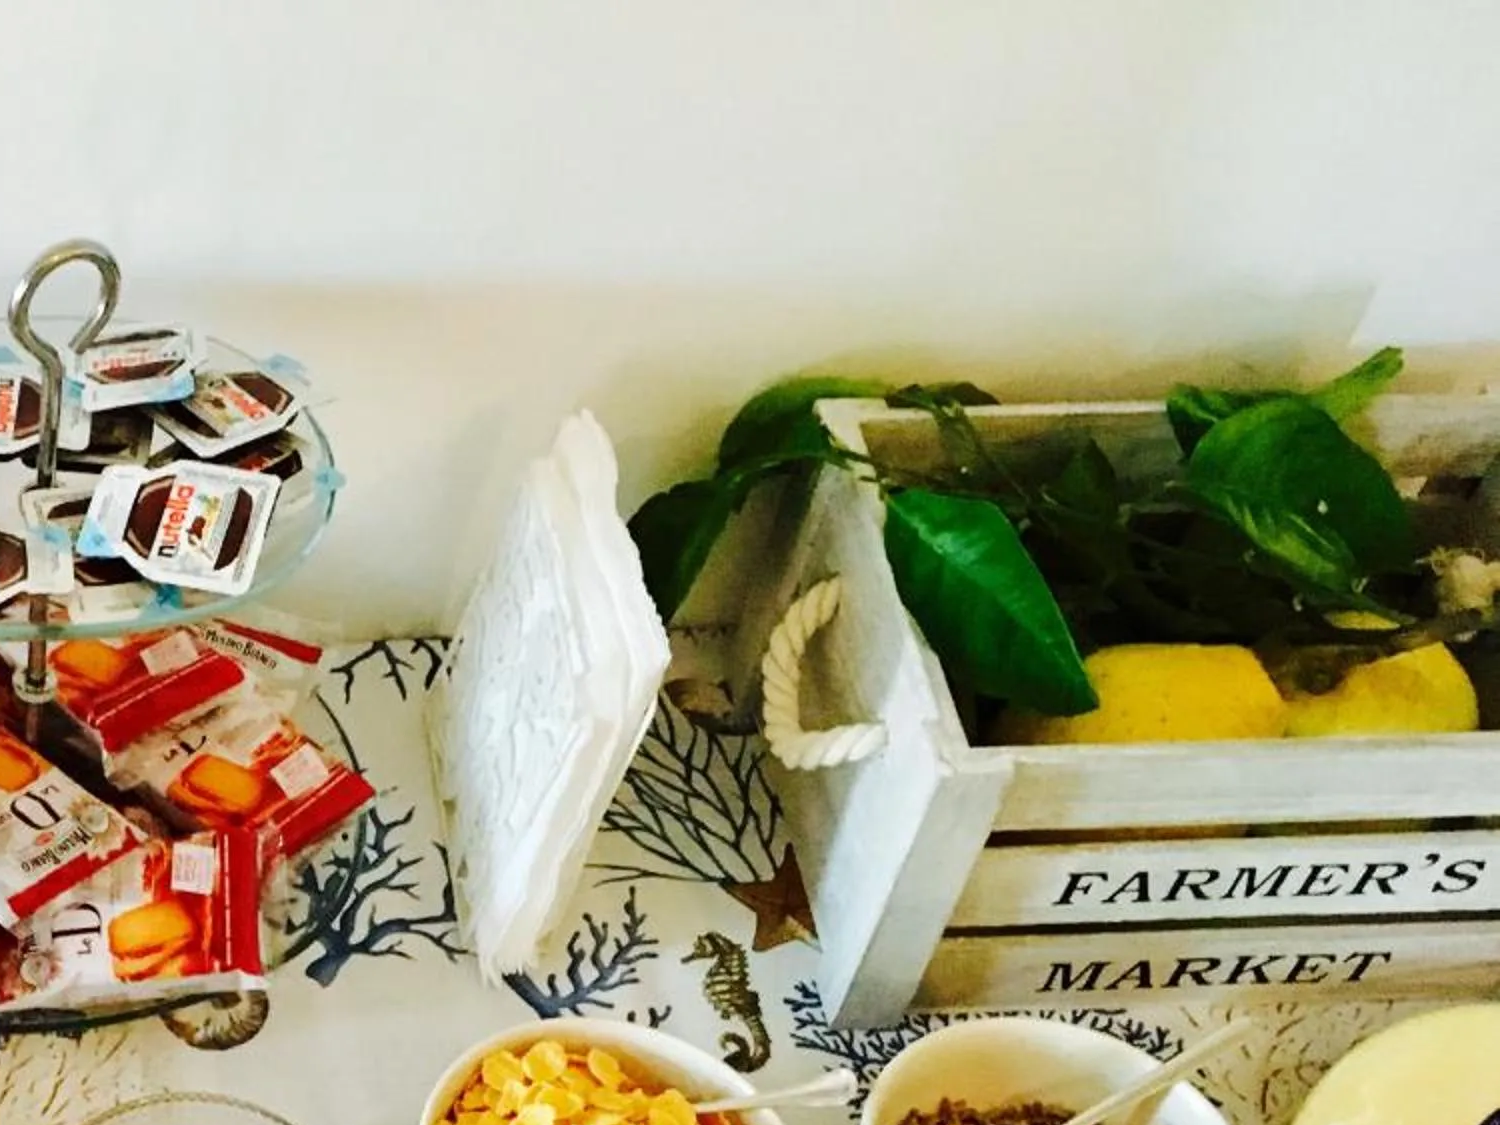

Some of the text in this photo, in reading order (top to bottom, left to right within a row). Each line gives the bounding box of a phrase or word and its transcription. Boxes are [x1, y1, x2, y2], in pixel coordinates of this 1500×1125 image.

[158, 484, 196, 558] nutella
[1052, 853, 1488, 905] FARMER'S
[1036, 952, 1392, 993] MARKET
